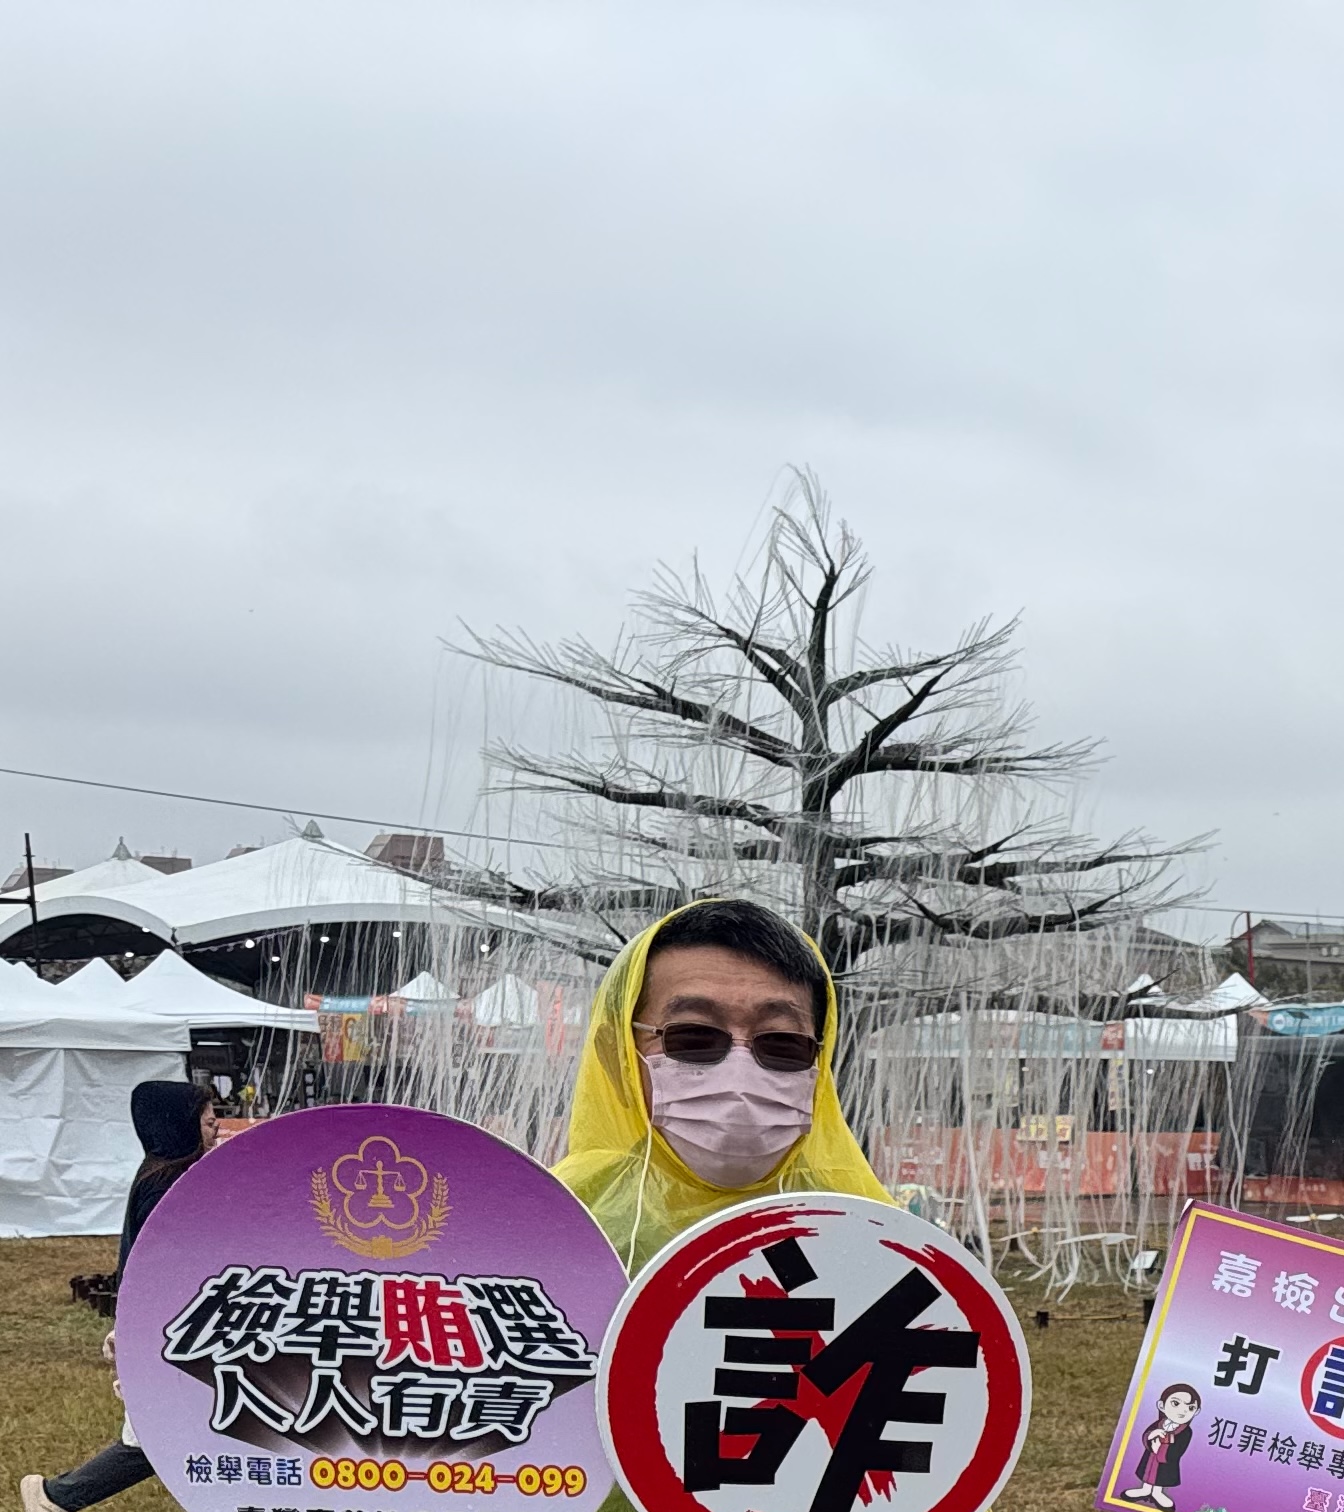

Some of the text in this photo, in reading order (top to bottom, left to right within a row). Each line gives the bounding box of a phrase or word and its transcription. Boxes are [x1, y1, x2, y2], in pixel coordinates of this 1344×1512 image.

[165, 1268, 596, 1373] 檢舉賄選
[1213, 1335, 1280, 1396] 打
[212, 1366, 552, 1442] 人人有責
[186, 1455, 587, 1497] 檢舉電話 0800-024-099
